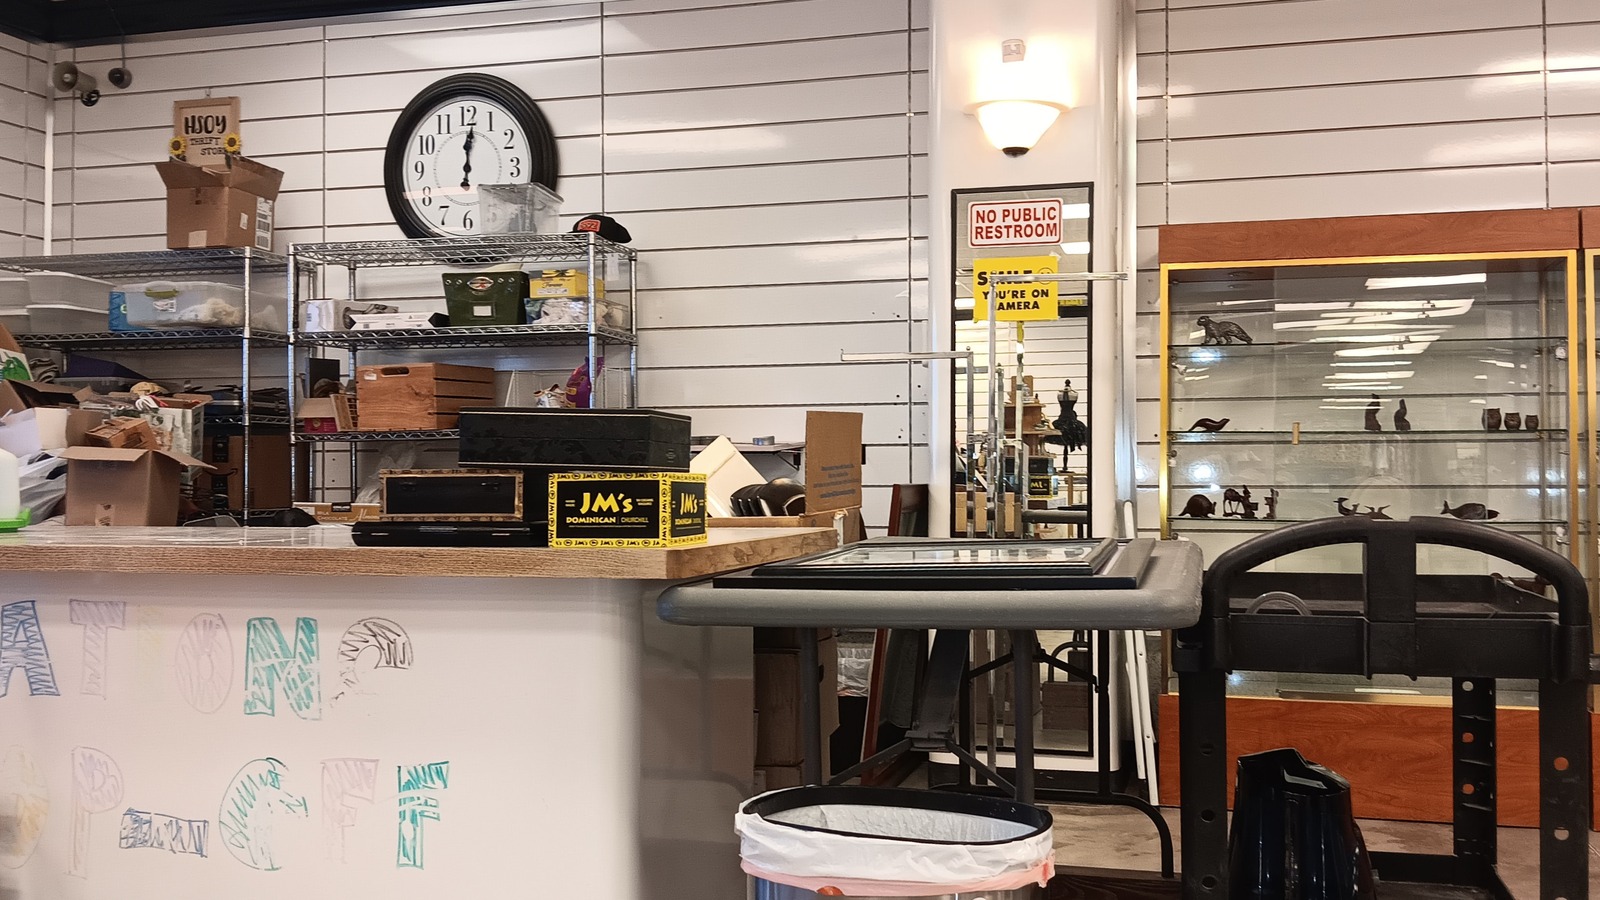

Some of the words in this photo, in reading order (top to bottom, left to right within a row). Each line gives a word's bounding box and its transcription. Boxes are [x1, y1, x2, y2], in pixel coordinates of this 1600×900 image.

[184, 115, 227, 135] HSOY
[436, 114, 451, 134] 11
[459, 105, 477, 126] 12
[486, 111, 495, 132] 1
[190, 137, 221, 145] THRIFT
[418, 134, 435, 155] 10
[503, 129, 514, 149] 2
[414, 161, 424, 181] 9
[510, 157, 520, 177] 3
[422, 186, 432, 206] 8
[439, 205, 449, 225] 7
[463, 210, 473, 230] 6
[976, 210, 997, 223] NO
[1002, 207, 1057, 222] PUBLIC
[975, 223, 1057, 239] RESTROOM
[982, 290, 1026, 300] YU'RE
[1031, 289, 1049, 298] ON
[996, 301, 1040, 311] AMERA
[580, 492, 633, 514] JM's
[680, 492, 698, 515] JM's
